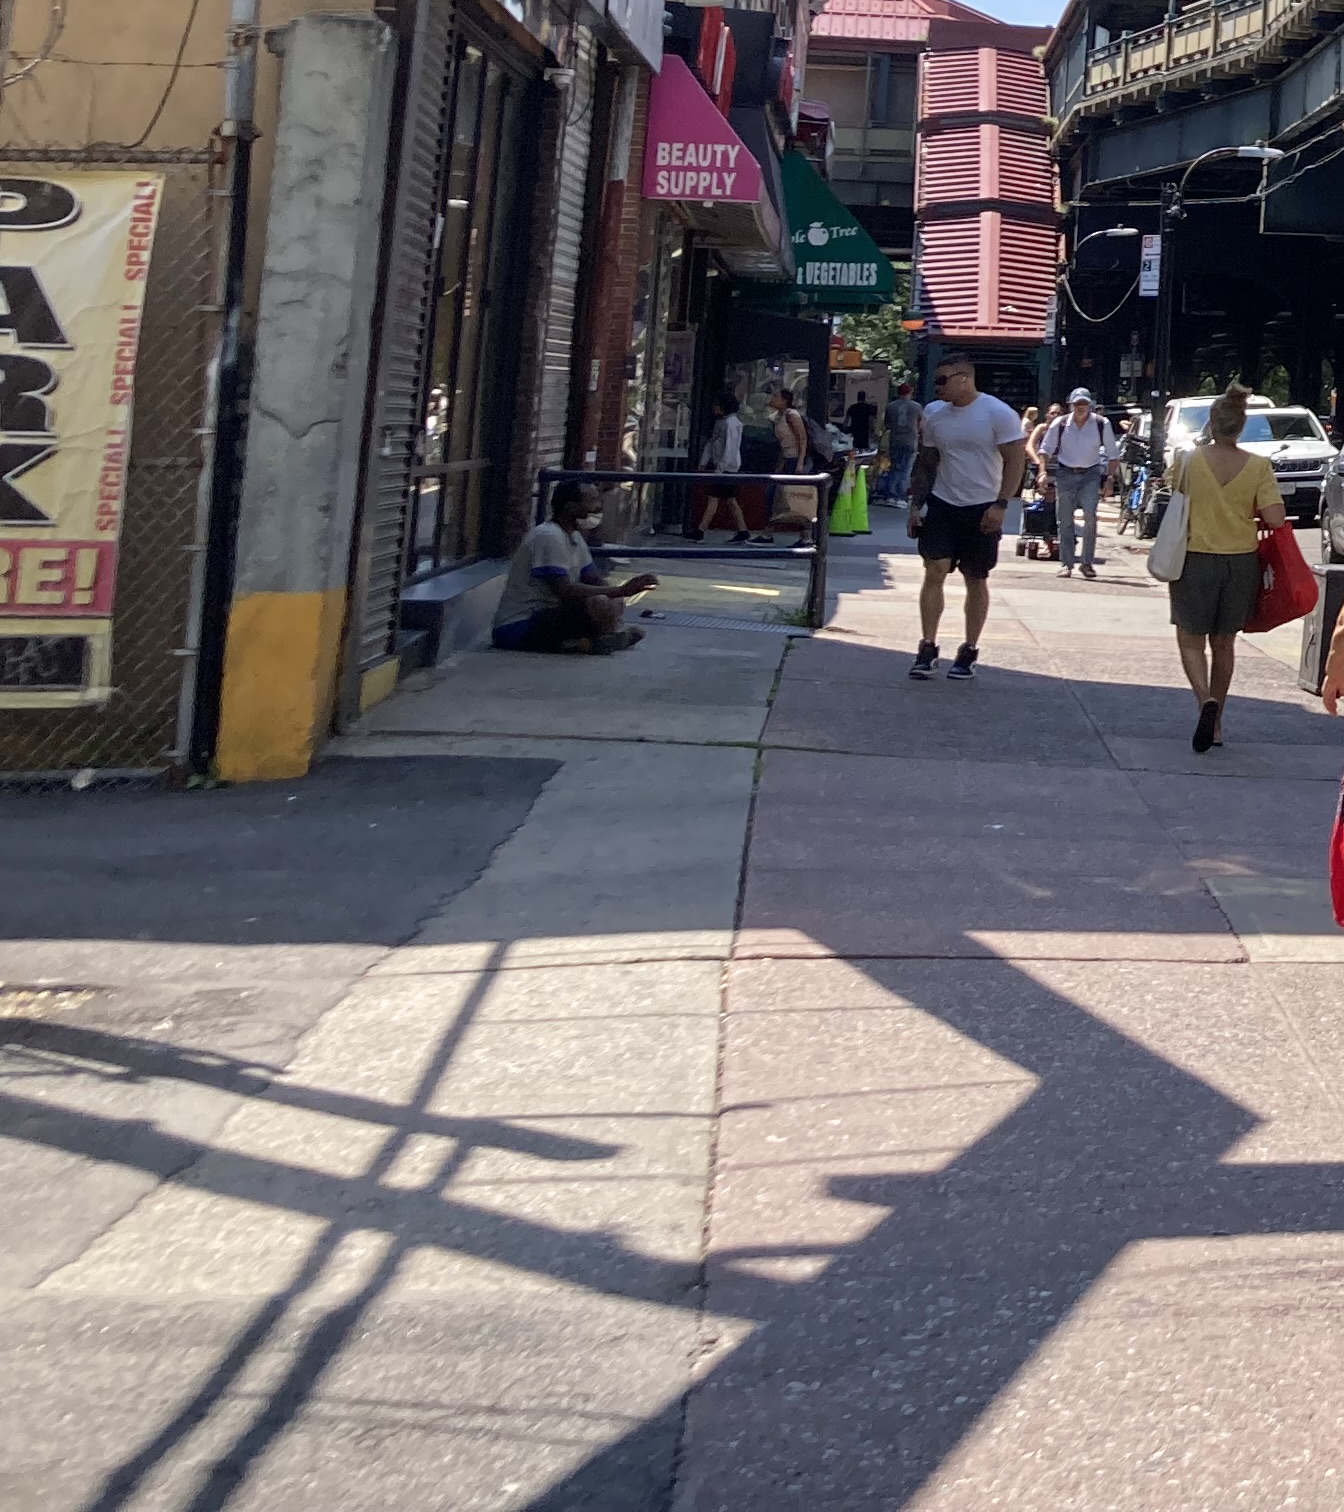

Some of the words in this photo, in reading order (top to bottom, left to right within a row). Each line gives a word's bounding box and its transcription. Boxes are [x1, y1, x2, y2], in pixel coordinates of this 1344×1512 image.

[656, 142, 741, 168] BEAUTY
[656, 171, 737, 196] SUPPLY
[123, 179, 158, 282] SPECIAL!
[830, 226, 858, 239] Tree
[806, 261, 878, 286] VEGETABLES
[111, 303, 141, 406] SPECIAL!
